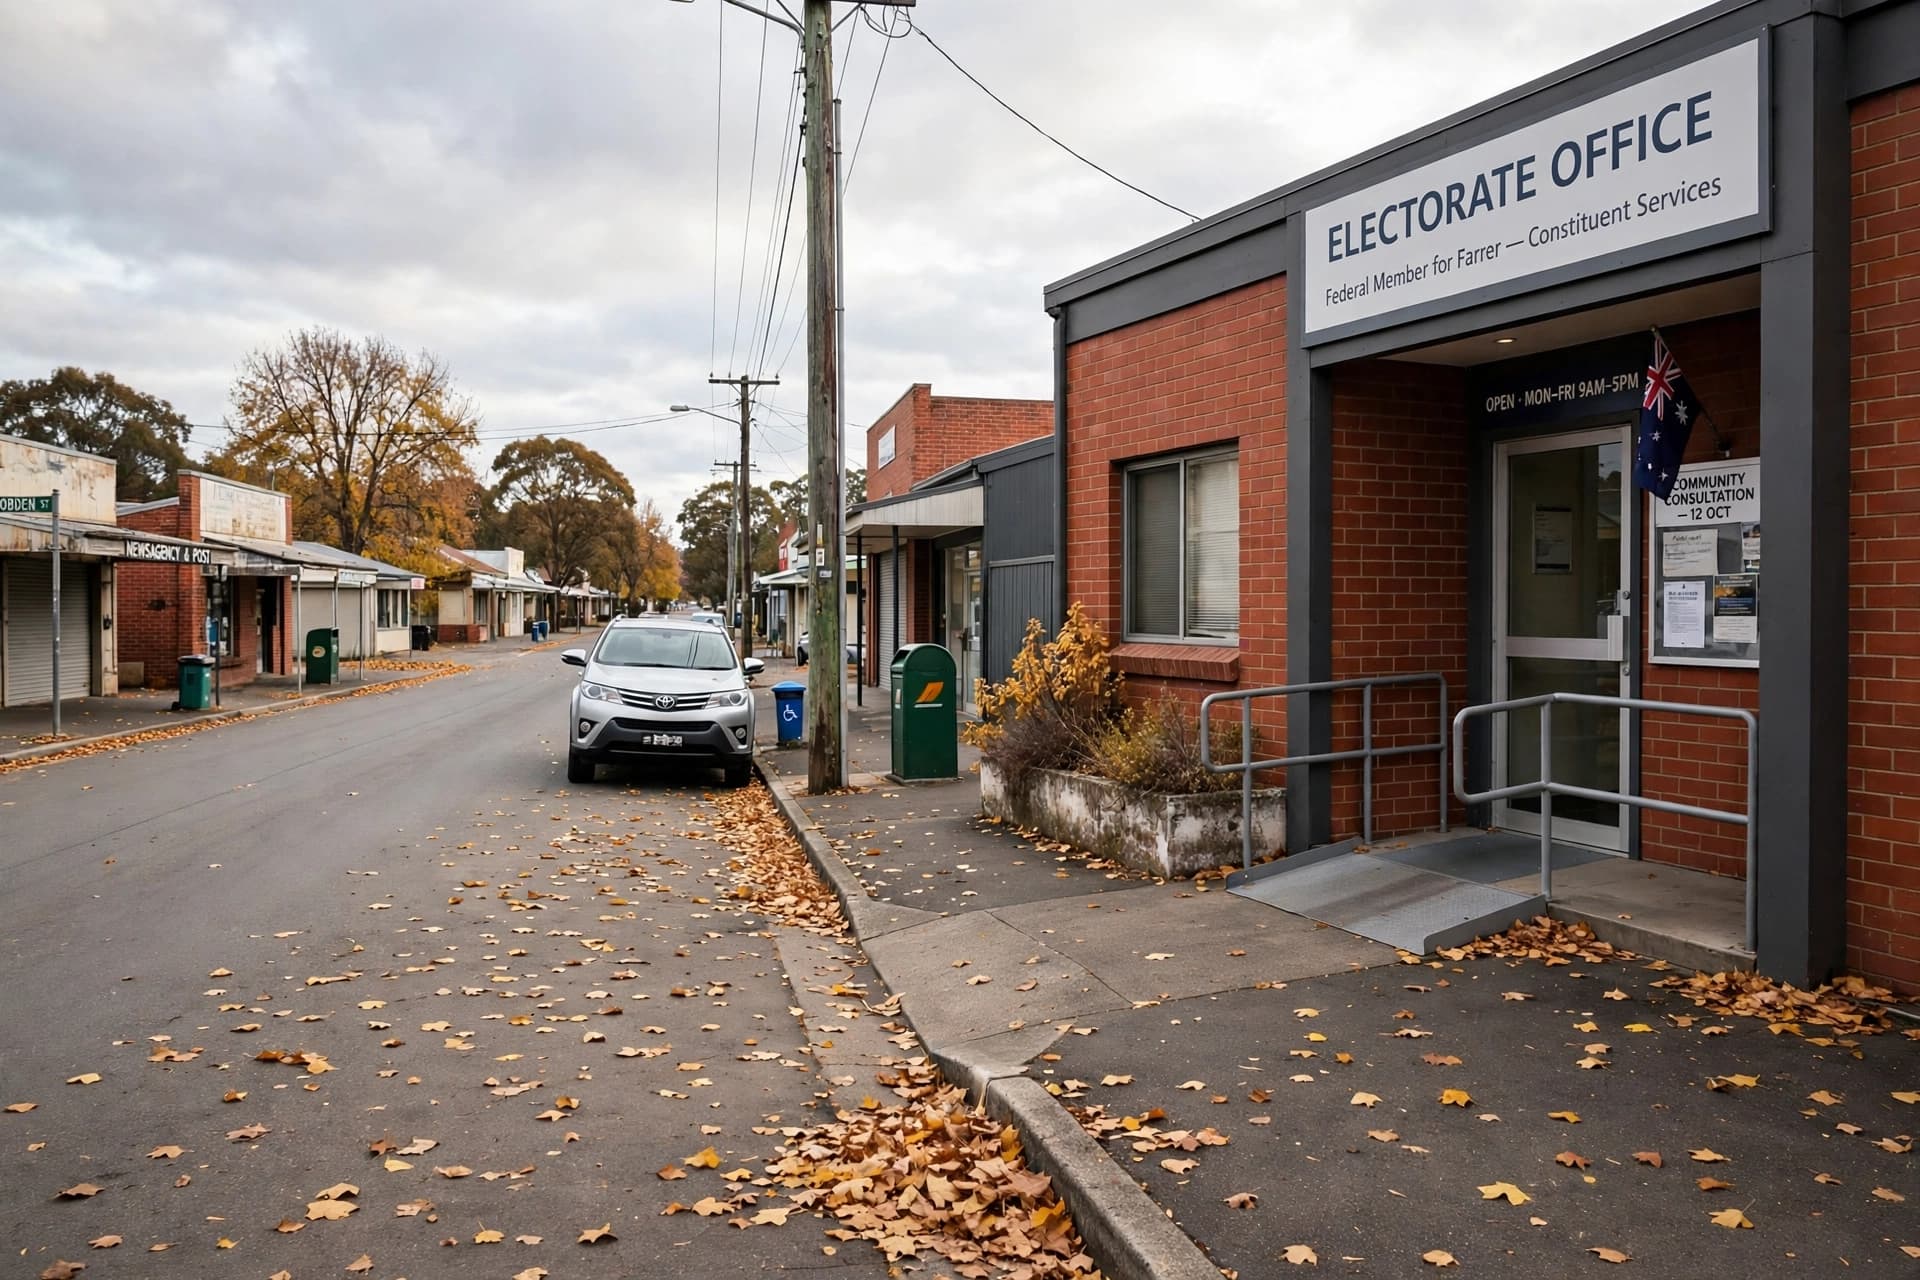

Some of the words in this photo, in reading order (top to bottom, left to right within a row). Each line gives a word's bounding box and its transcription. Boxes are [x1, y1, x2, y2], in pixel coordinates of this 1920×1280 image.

[1329, 155, 1536, 262] ELECTORATE
[1551, 91, 1712, 187] OFFICE
[1326, 277, 1369, 306] Federal
[1374, 263, 1428, 293] Member
[1432, 254, 1452, 275] for
[1457, 242, 1501, 268] Farrer
[1528, 201, 1631, 247] Constituent
[1637, 177, 1722, 216] Services
[1486, 393, 1515, 412] OPEN
[1664, 487, 1755, 506] CONSULTATION
[1690, 508, 1703, 520] 12
[1706, 506, 1732, 519] OCT
[126, 540, 181, 561] NEWSAGENCY
[192, 547, 210, 564] POST
